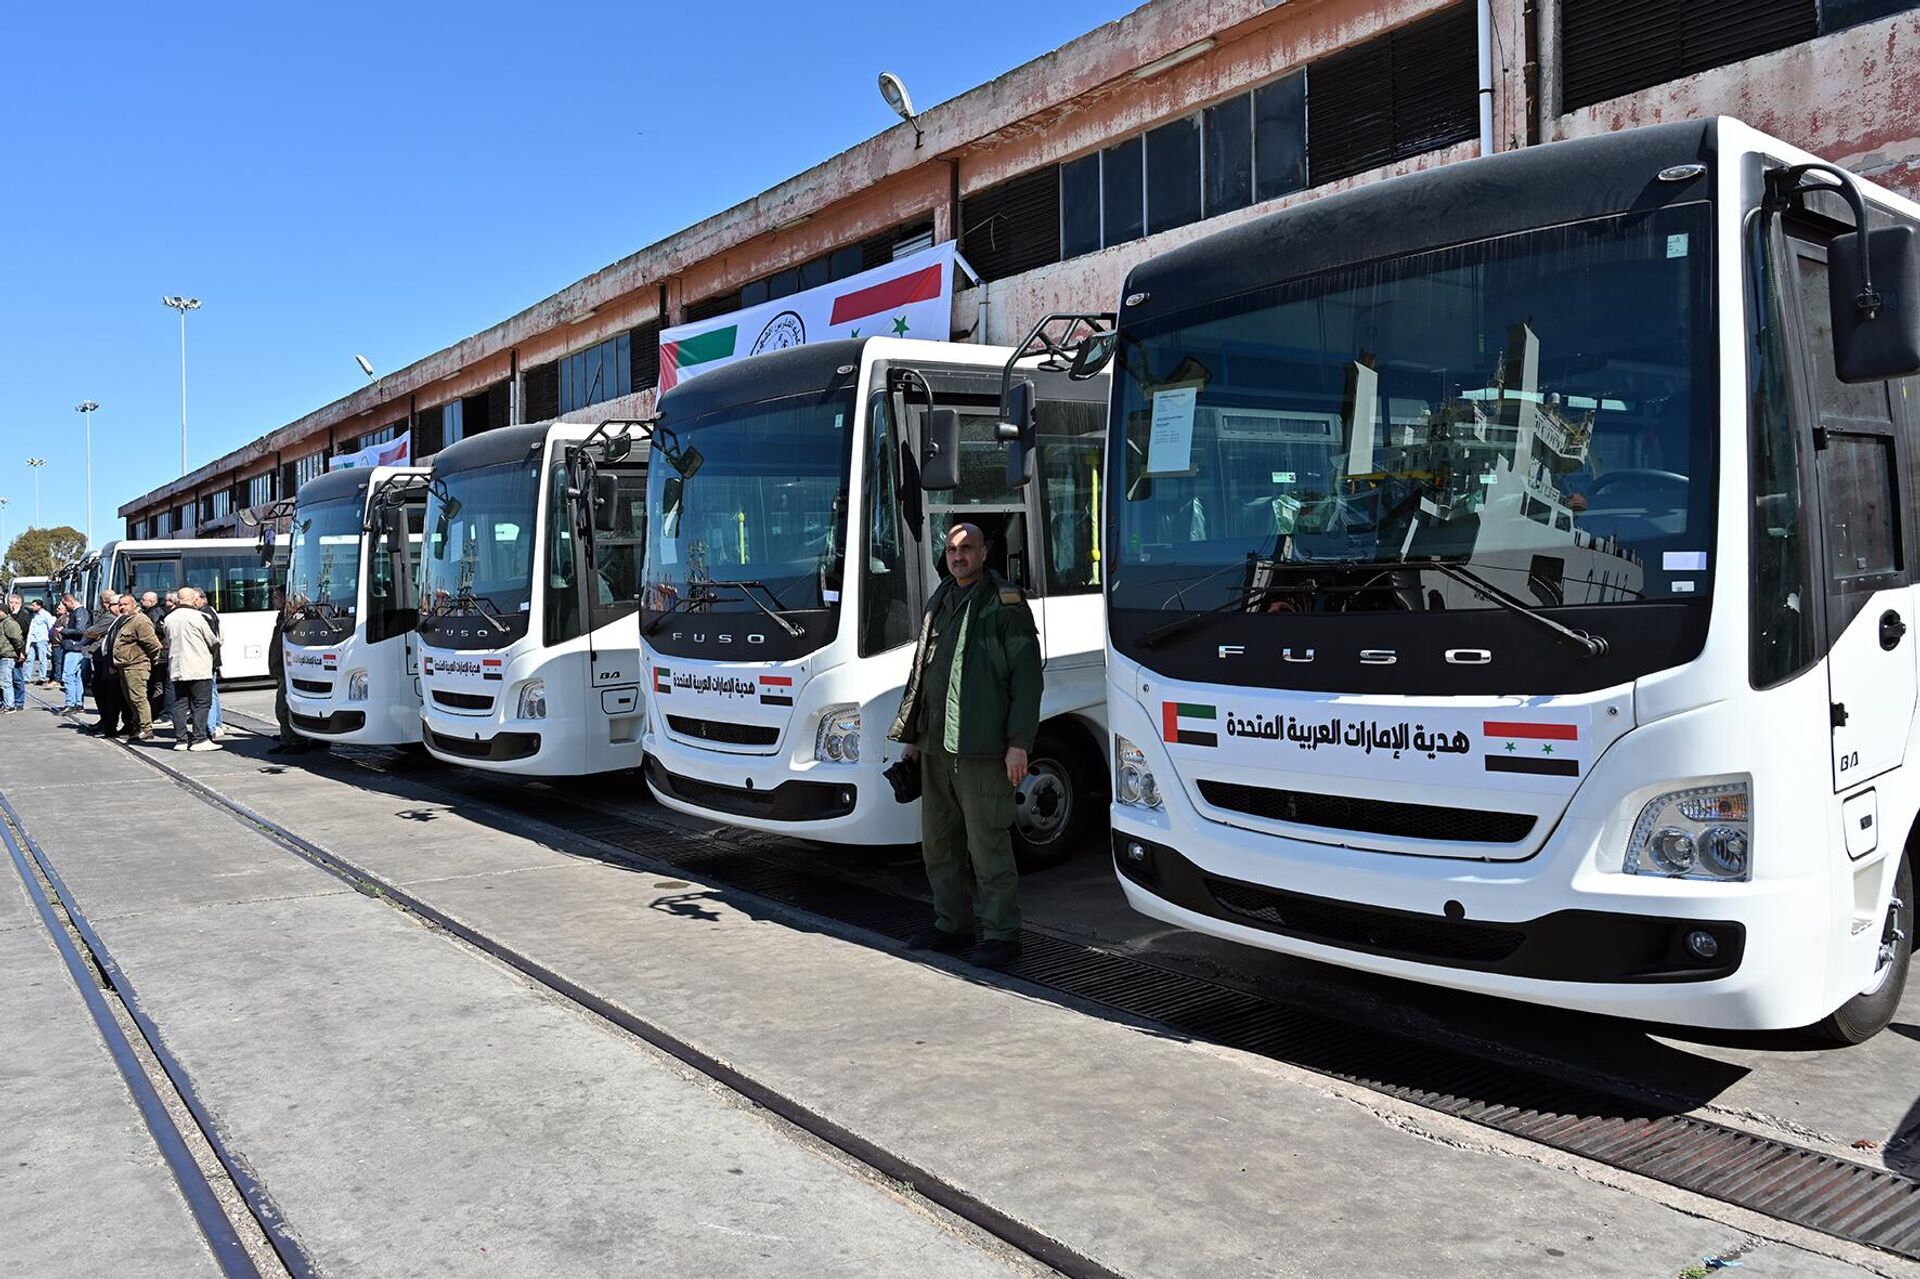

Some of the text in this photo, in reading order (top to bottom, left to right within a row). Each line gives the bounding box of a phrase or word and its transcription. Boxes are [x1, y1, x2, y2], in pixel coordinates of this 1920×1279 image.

[672, 632, 765, 644] FUSO
[1218, 645, 1491, 665] FUSO
[599, 671, 621, 680] BA
[673, 672, 693, 688] المتحدة
[693, 674, 712, 693] العربية
[735, 678, 756, 698] هدية
[1226, 712, 1470, 759] هدية الإمارات العربية المتحدة
[1840, 751, 1859, 772] BA
